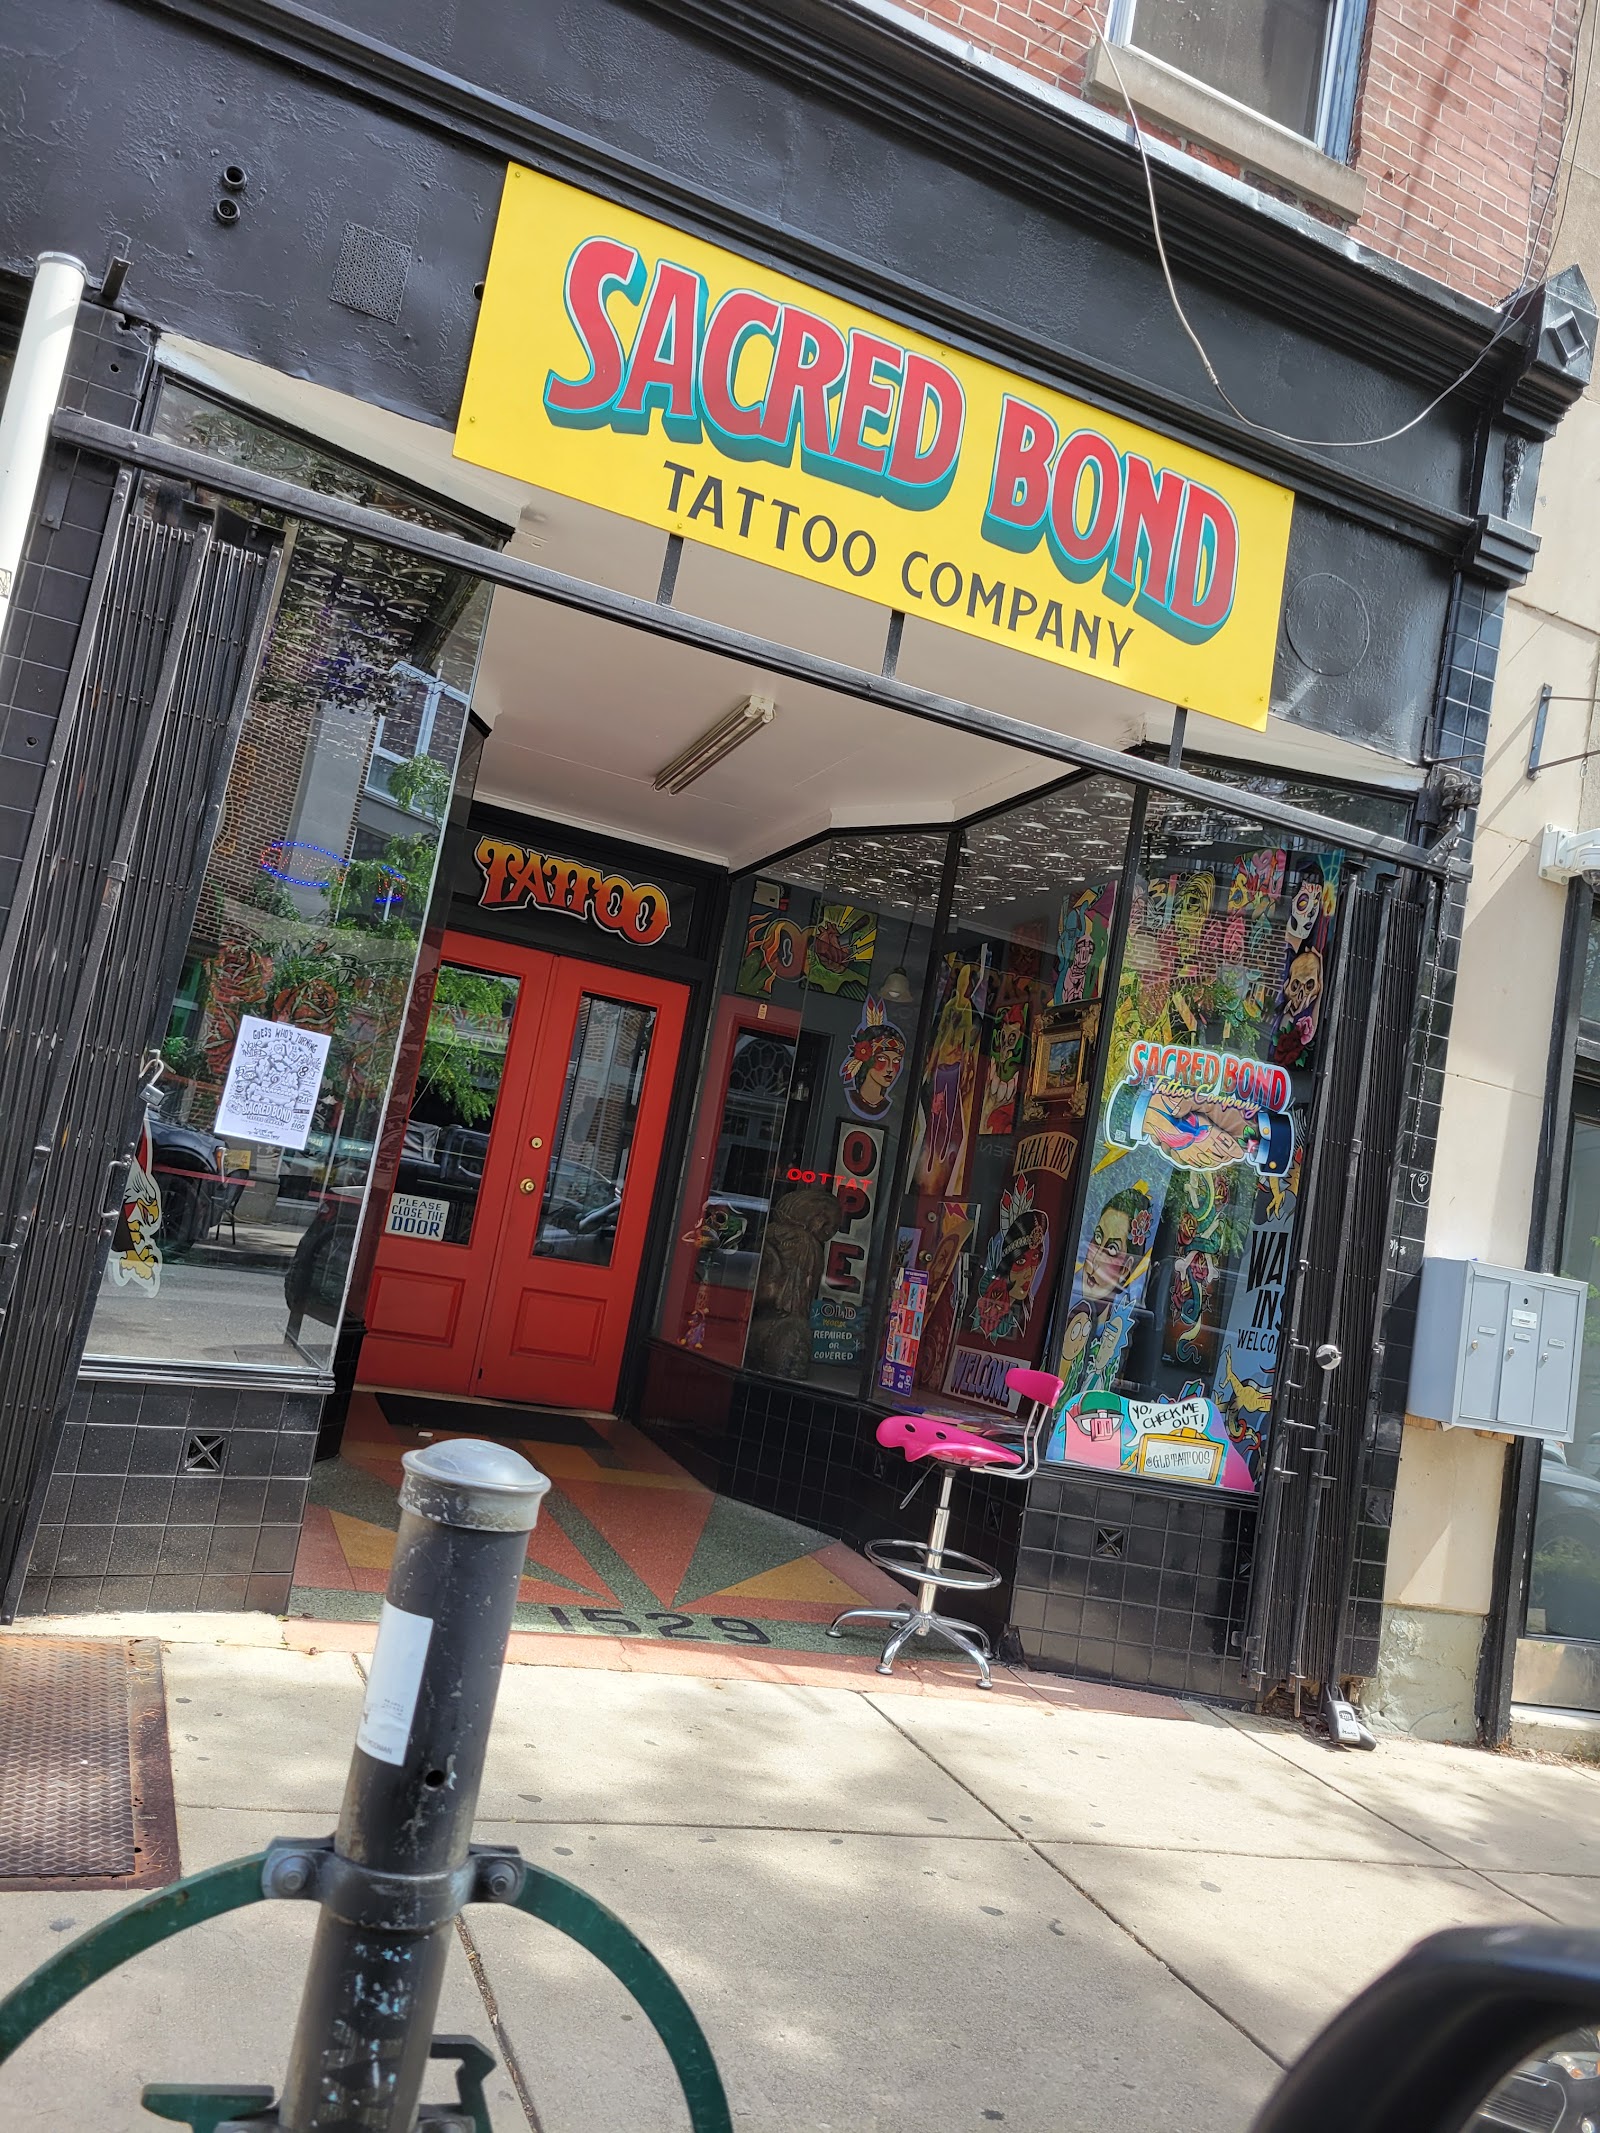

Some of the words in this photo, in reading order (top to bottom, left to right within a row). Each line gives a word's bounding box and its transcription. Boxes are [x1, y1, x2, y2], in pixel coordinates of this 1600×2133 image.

[545, 236, 966, 512] SACRED
[981, 394, 1239, 645] BOND
[664, 461, 877, 577] TATTOO
[901, 552, 1135, 668] COMPANY
[474, 836, 671, 946] TATTOO
[1129, 1043, 1220, 1088] SACRED
[1223, 1058, 1287, 1112] BOND
[1150, 1075, 1195, 1100] Tattoo
[1194, 1084, 1262, 1119] Company
[241, 1101, 271, 1116] SACRED
[272, 1104, 292, 1123] BOND
[1017, 1136, 1075, 1173] WALK-INS
[392, 1205, 423, 1219] CLOSE
[428, 1210, 444, 1222] THE
[399, 1197, 441, 1211] PLEASE
[391, 1216, 440, 1237] DOOR
[822, 1130, 877, 1304] OPE
[1246, 1231, 1289, 1293] WA
[821, 1303, 856, 1320] OLD
[814, 1330, 852, 1340] REPAIRED
[1237, 1329, 1280, 1354] WELCO
[814, 1351, 854, 1360] COVERED
[1132, 1404, 1152, 1419] YO,
[1143, 1406, 1182, 1429] CHECK
[1182, 1403, 1200, 1415] ME
[1172, 1414, 1206, 1429] OUT!
[549, 1606, 771, 1645] 1529
